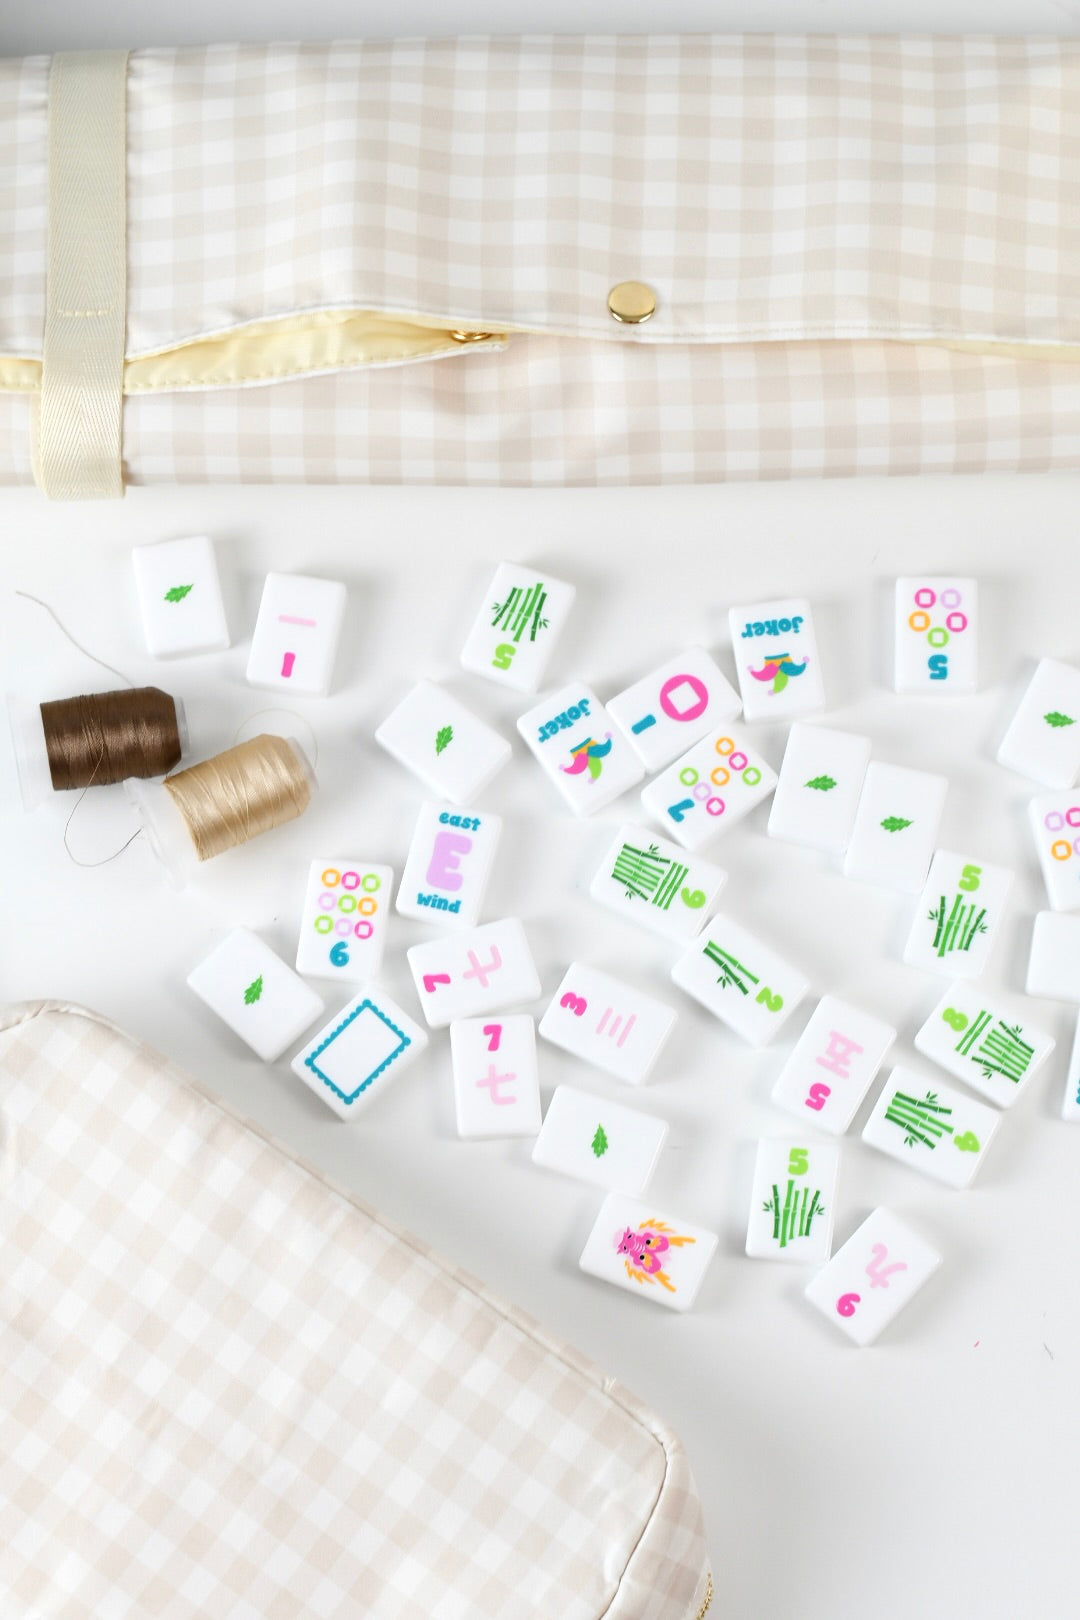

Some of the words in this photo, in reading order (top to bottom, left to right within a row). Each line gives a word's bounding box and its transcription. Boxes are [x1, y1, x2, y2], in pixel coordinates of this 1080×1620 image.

[740, 615, 804, 639] joker
[491, 642, 517, 670] 5
[927, 653, 948, 680] 5
[537, 698, 592, 743] joker
[438, 811, 482, 832] east
[667, 798, 696, 823] 7
[426, 831, 473, 892] E
[958, 864, 982, 892] 5
[416, 892, 462, 914] wind
[680, 886, 707, 909] 9
[423, 973, 451, 993] 7
[560, 991, 588, 1017] 3
[755, 986, 784, 1012] 2
[942, 1007, 969, 1032] 8
[482, 1023, 503, 1052] 7
[804, 1083, 832, 1112] 5
[953, 1131, 981, 1153] 4
[787, 1147, 809, 1176] 5
